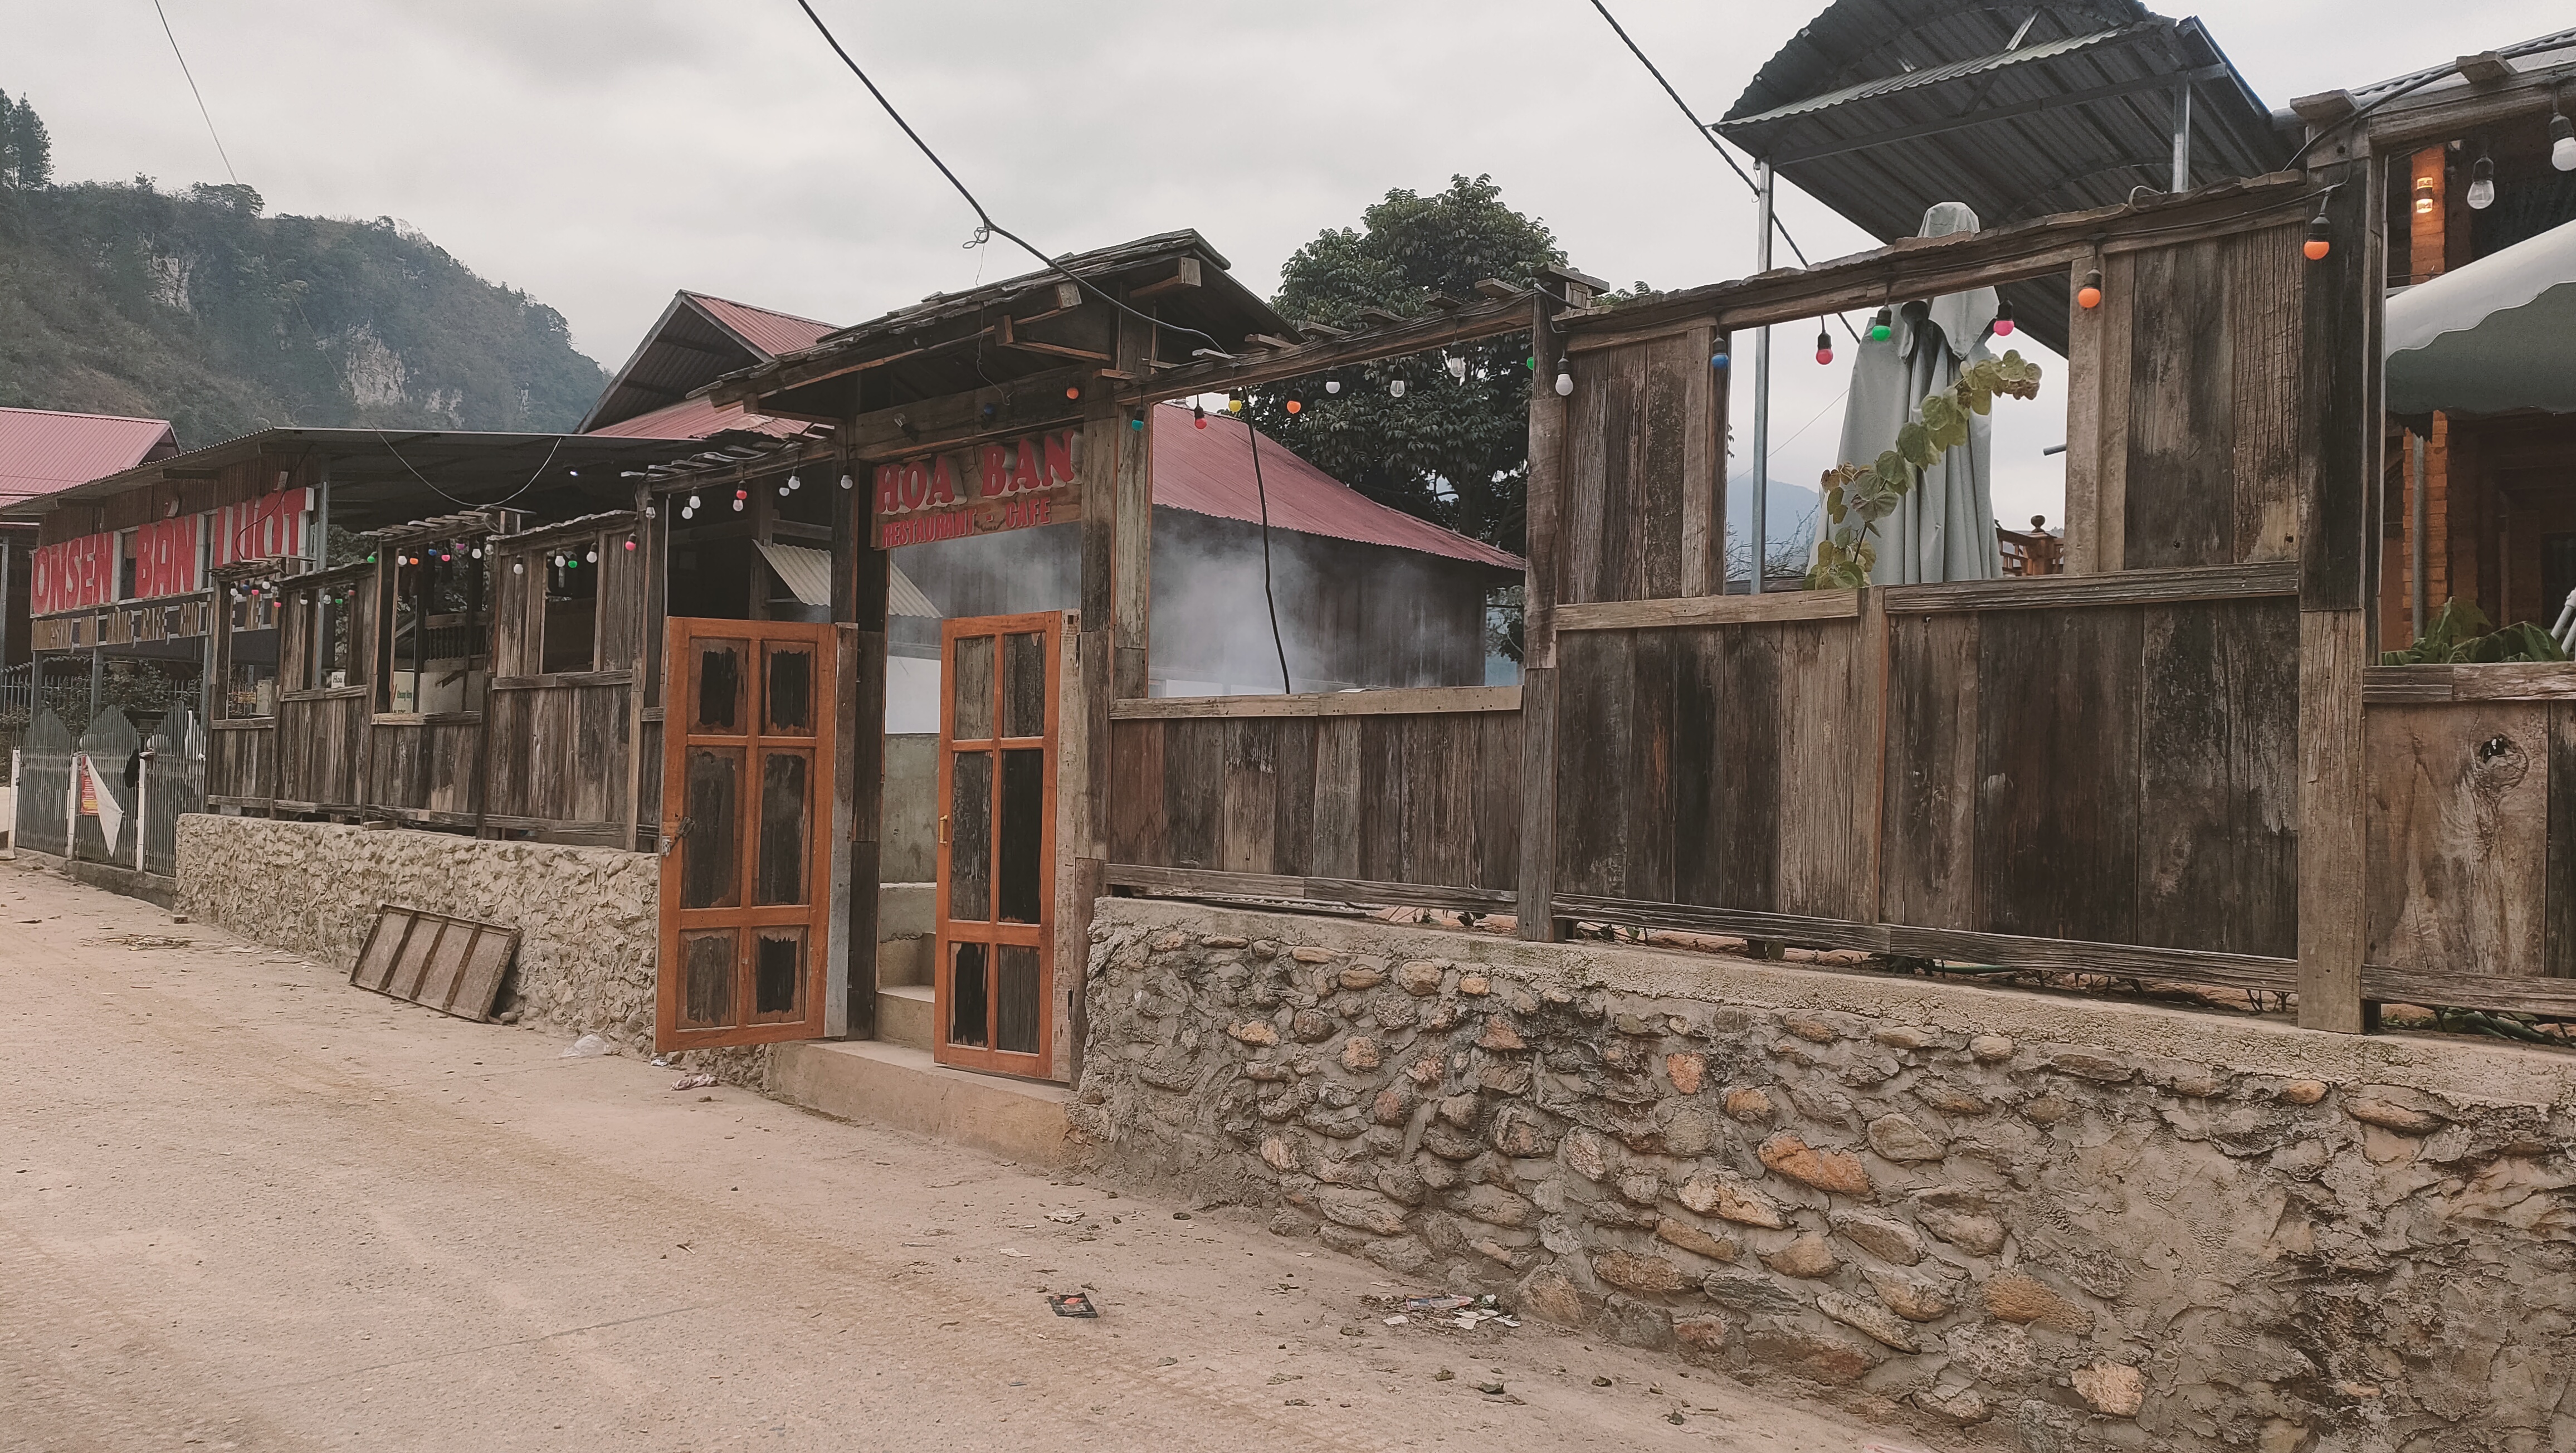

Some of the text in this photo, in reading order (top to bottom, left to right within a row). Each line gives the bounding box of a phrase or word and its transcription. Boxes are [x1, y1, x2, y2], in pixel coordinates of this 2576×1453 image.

[874, 429, 1075, 516] HOA BAN
[882, 496, 1052, 548] RESTAURANT CAFE
[32, 531, 115, 613] ONSEN
[178, 601, 201, 637] CHO
